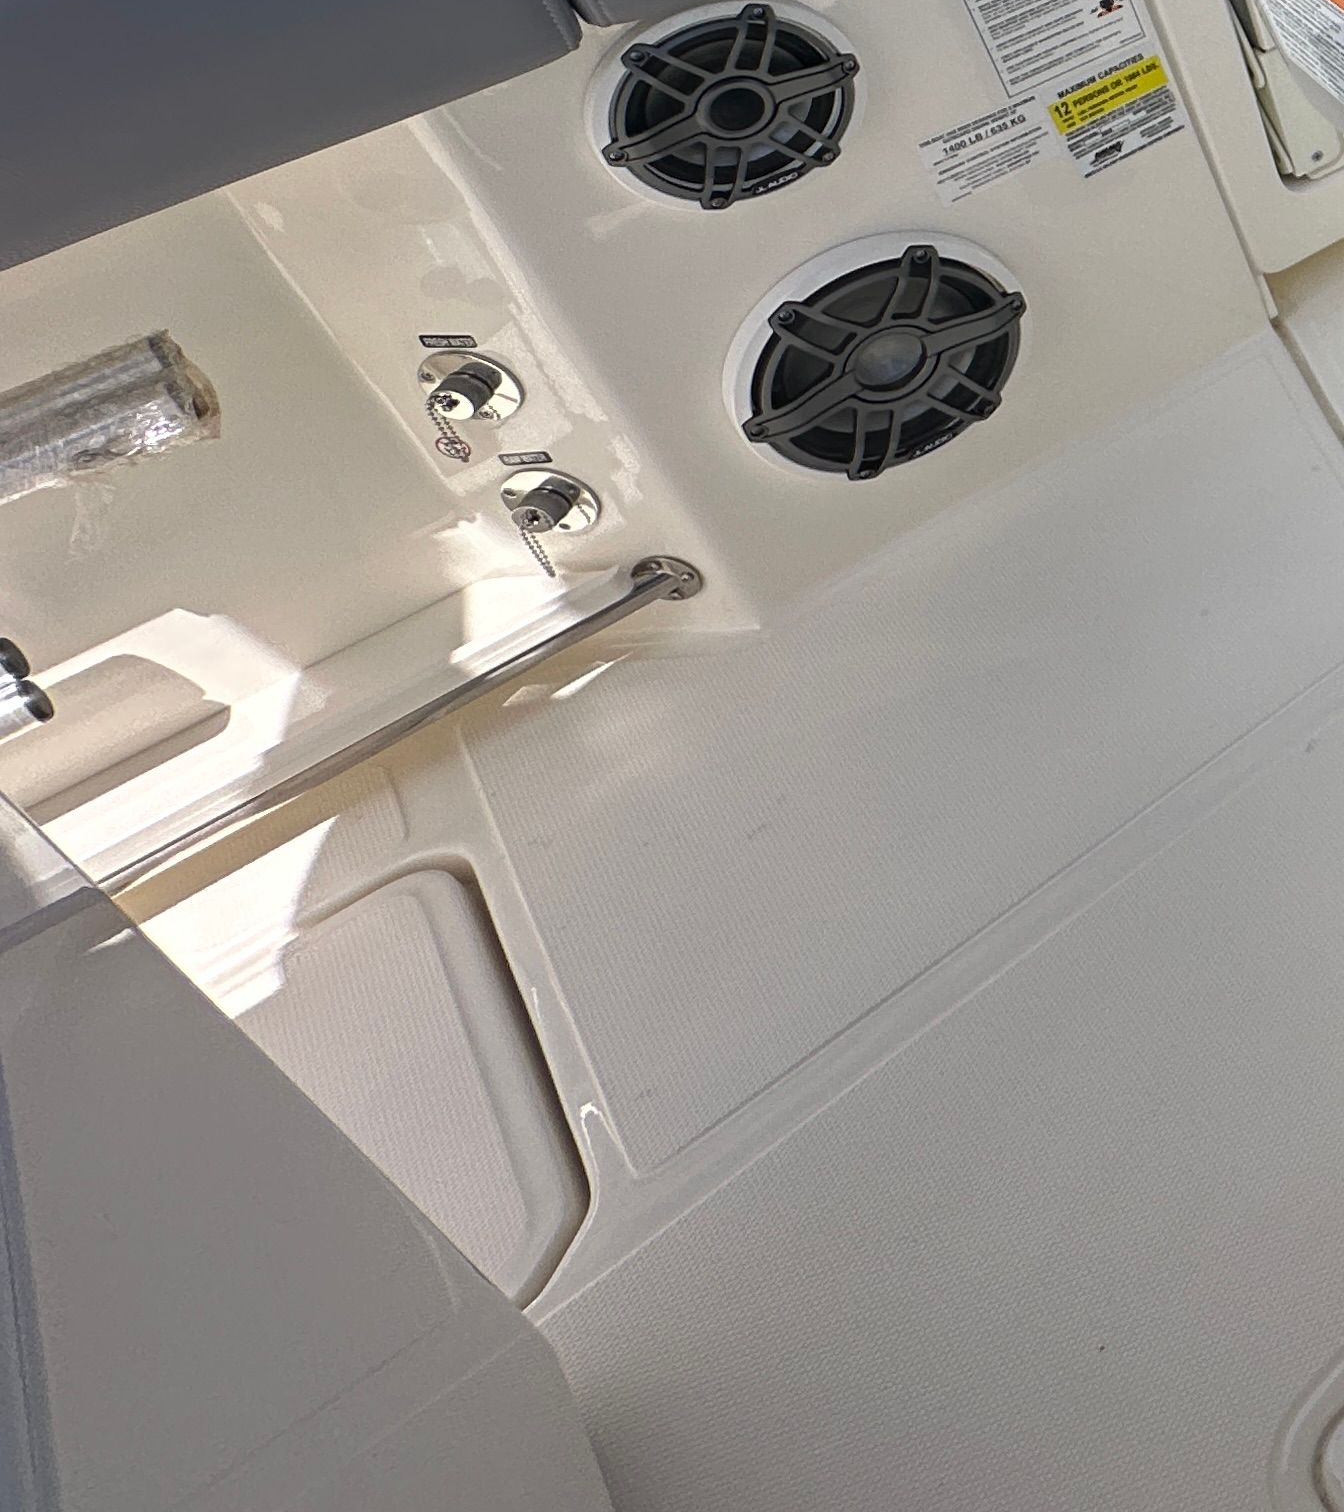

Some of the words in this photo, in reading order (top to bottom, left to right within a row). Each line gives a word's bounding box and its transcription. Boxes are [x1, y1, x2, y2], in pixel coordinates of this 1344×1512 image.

[1057, 76, 1096, 99] MAXIMUM
[1097, 53, 1144, 79] CAPACITIES
[1054, 101, 1072, 118] 12
[942, 140, 967, 156] 1400
[968, 133, 983, 145] LB
[1010, 114, 1026, 128] KG
[768, 171, 799, 189] AUDIO
